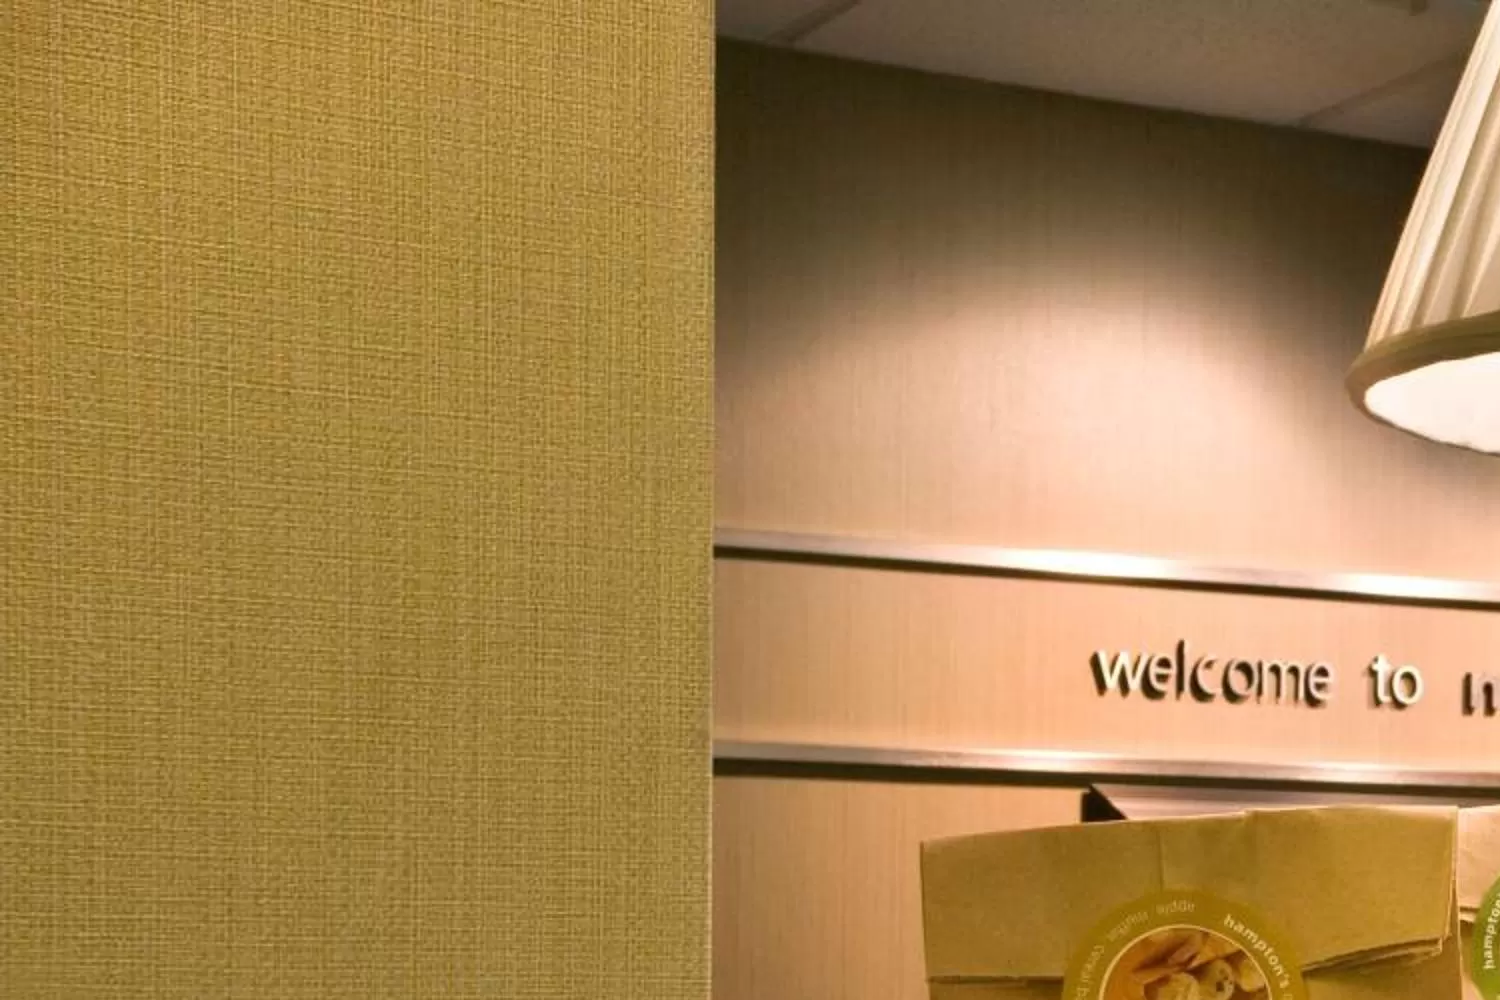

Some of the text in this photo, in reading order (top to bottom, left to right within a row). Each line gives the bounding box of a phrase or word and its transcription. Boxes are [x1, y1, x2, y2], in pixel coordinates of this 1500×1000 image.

[1090, 640, 1333, 709] welcome
[1368, 653, 1425, 708] to
[1222, 913, 1291, 990] hampton's
